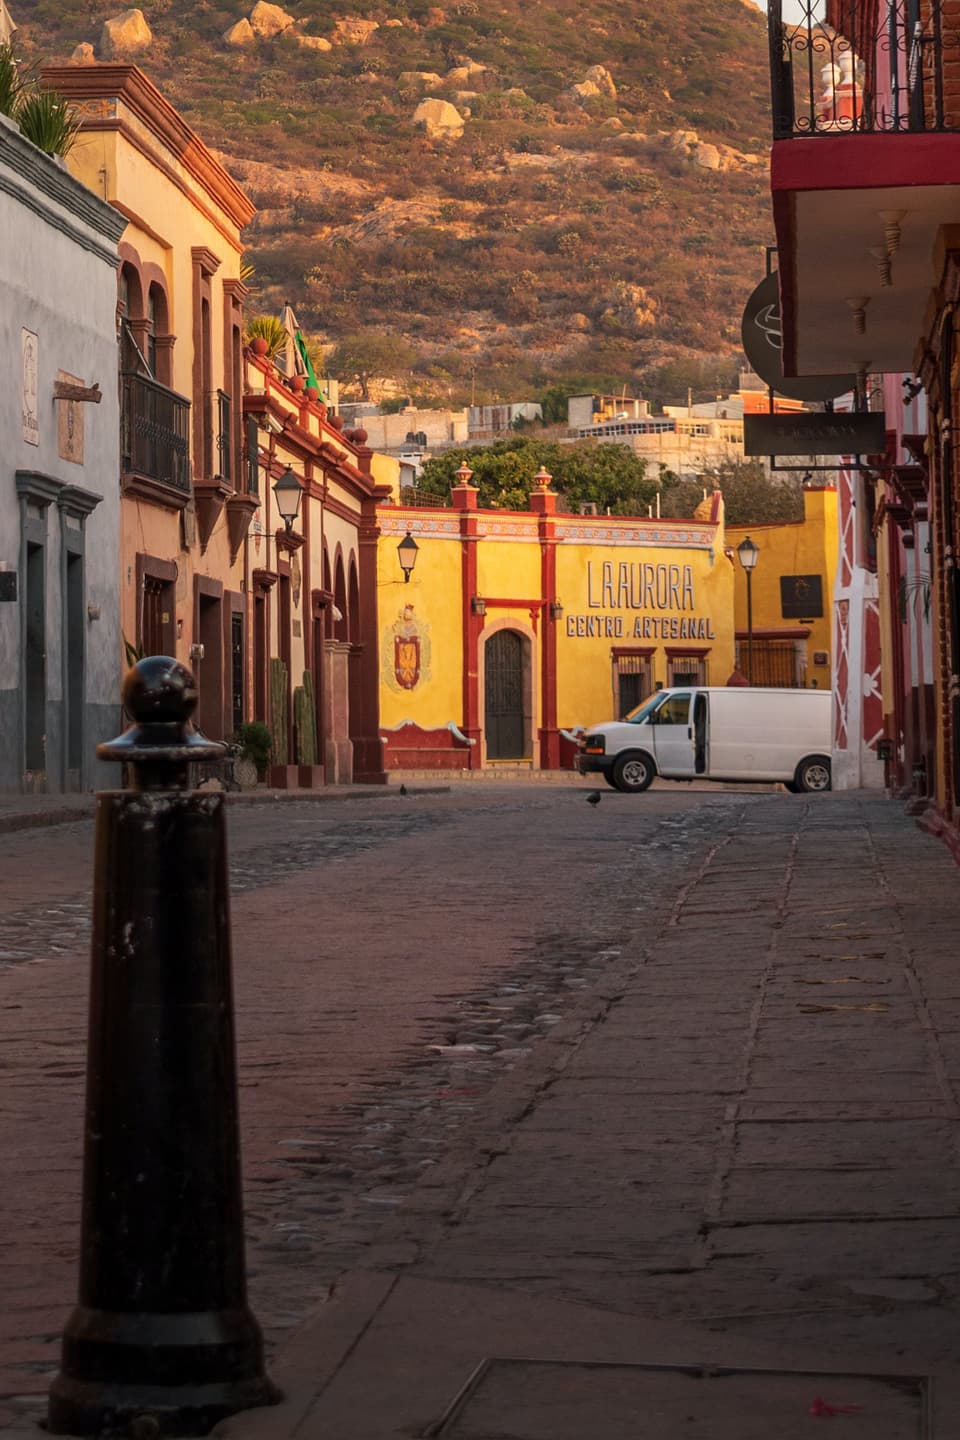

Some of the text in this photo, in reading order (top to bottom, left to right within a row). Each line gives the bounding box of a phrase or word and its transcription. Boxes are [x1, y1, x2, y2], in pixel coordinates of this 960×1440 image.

[617, 562, 695, 611] AURORA
[566, 615, 716, 640] CENTRO ARTESANAL
